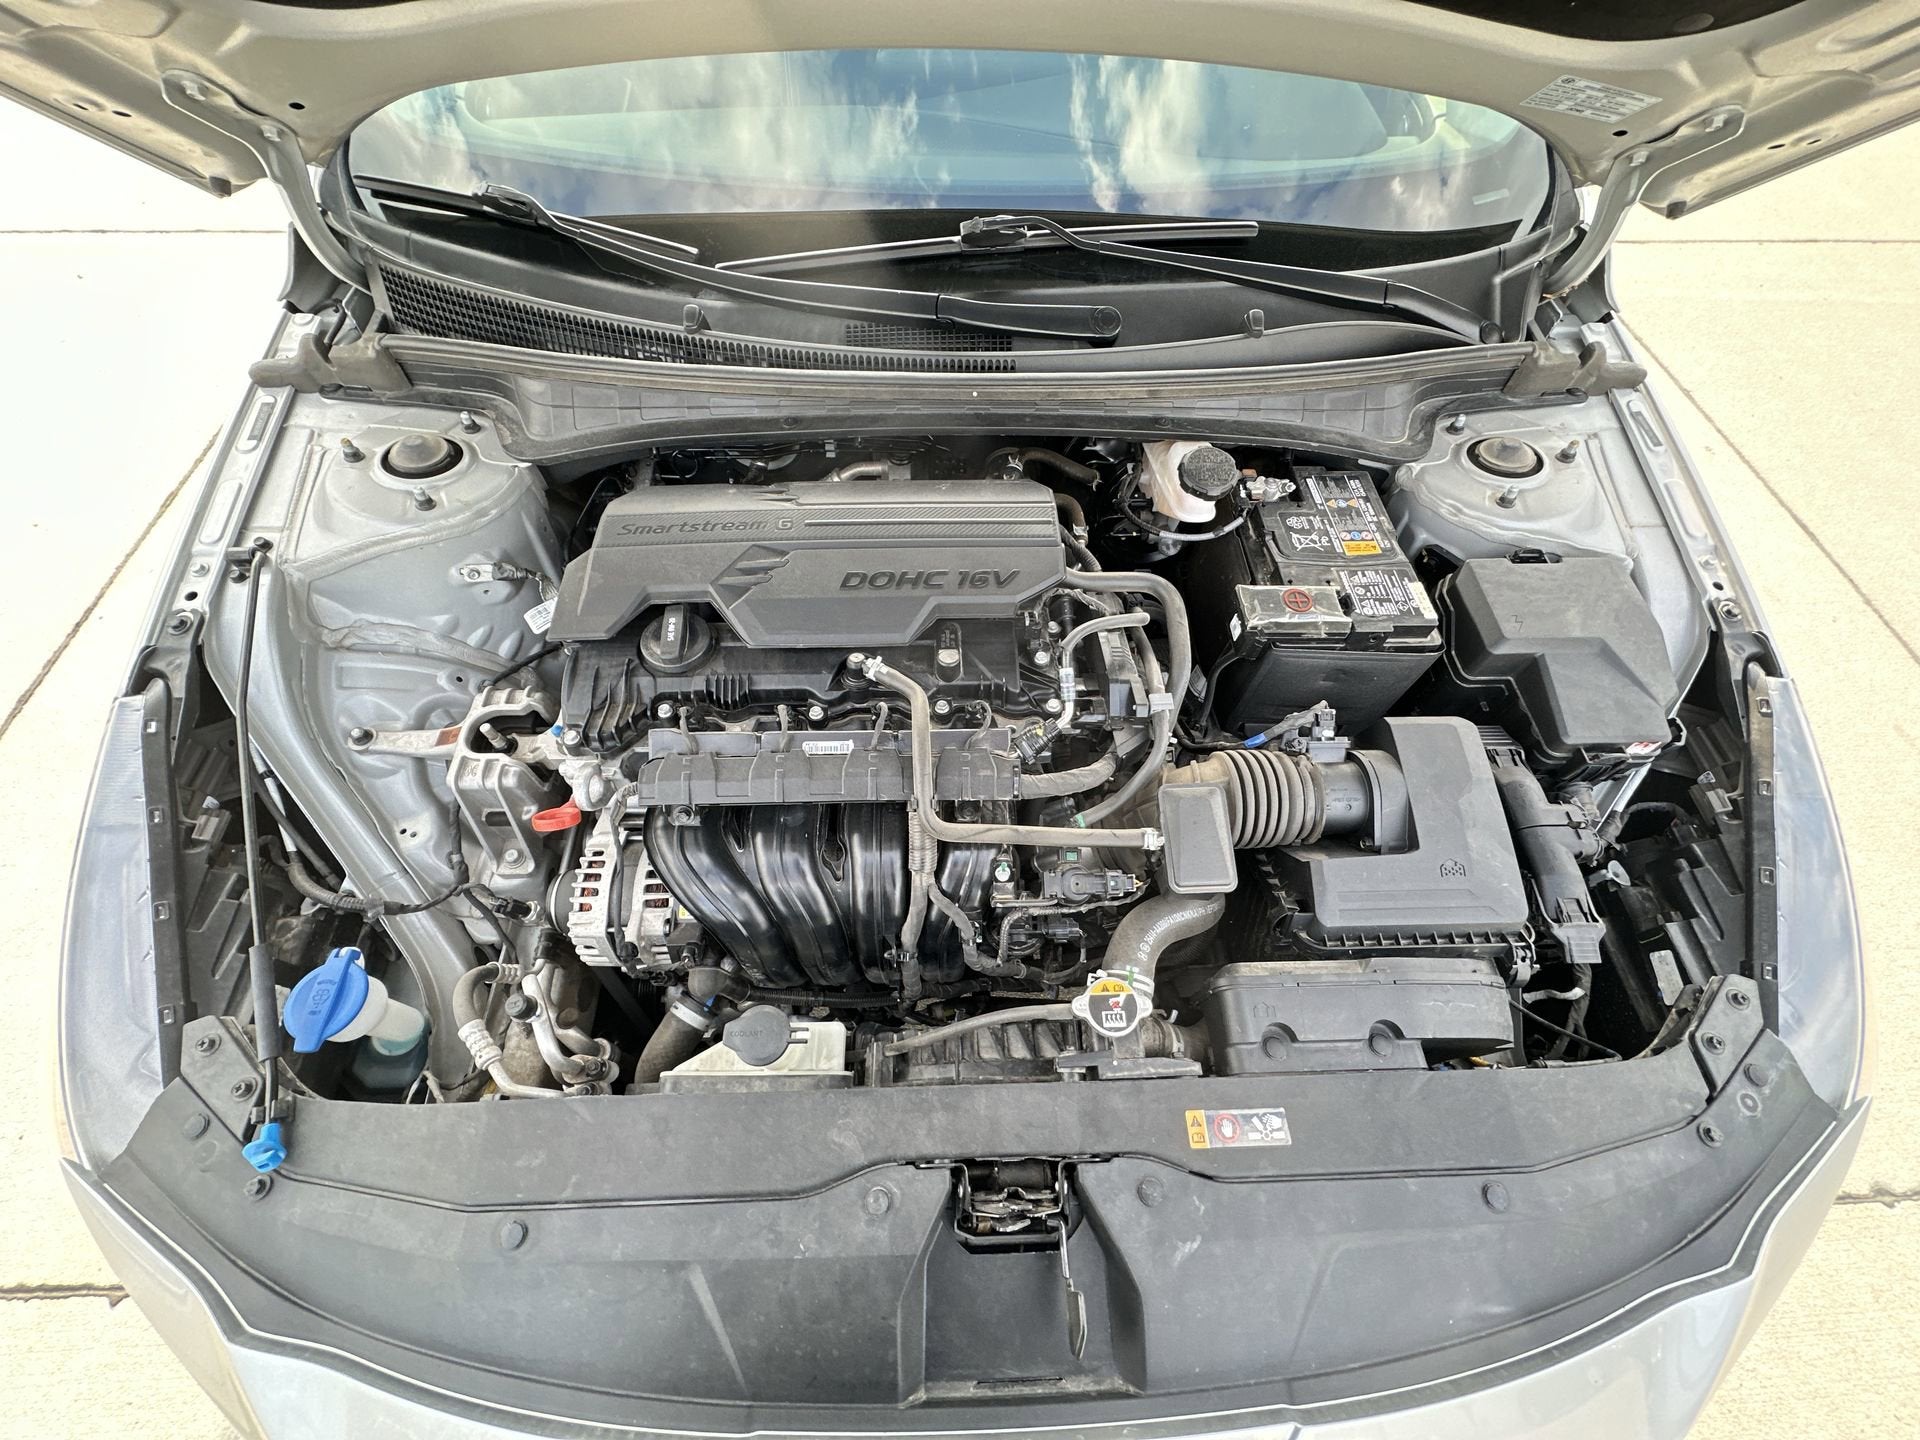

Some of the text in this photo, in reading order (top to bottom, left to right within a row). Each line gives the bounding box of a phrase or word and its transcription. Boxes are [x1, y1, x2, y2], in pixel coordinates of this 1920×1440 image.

[616, 518, 793, 536] Smartstream G
[1321, 535, 1331, 546] Pb
[840, 568, 1021, 590] DOHC 16V
[667, 631, 675, 641] SAE
[729, 1030, 763, 1038] COOLANT
